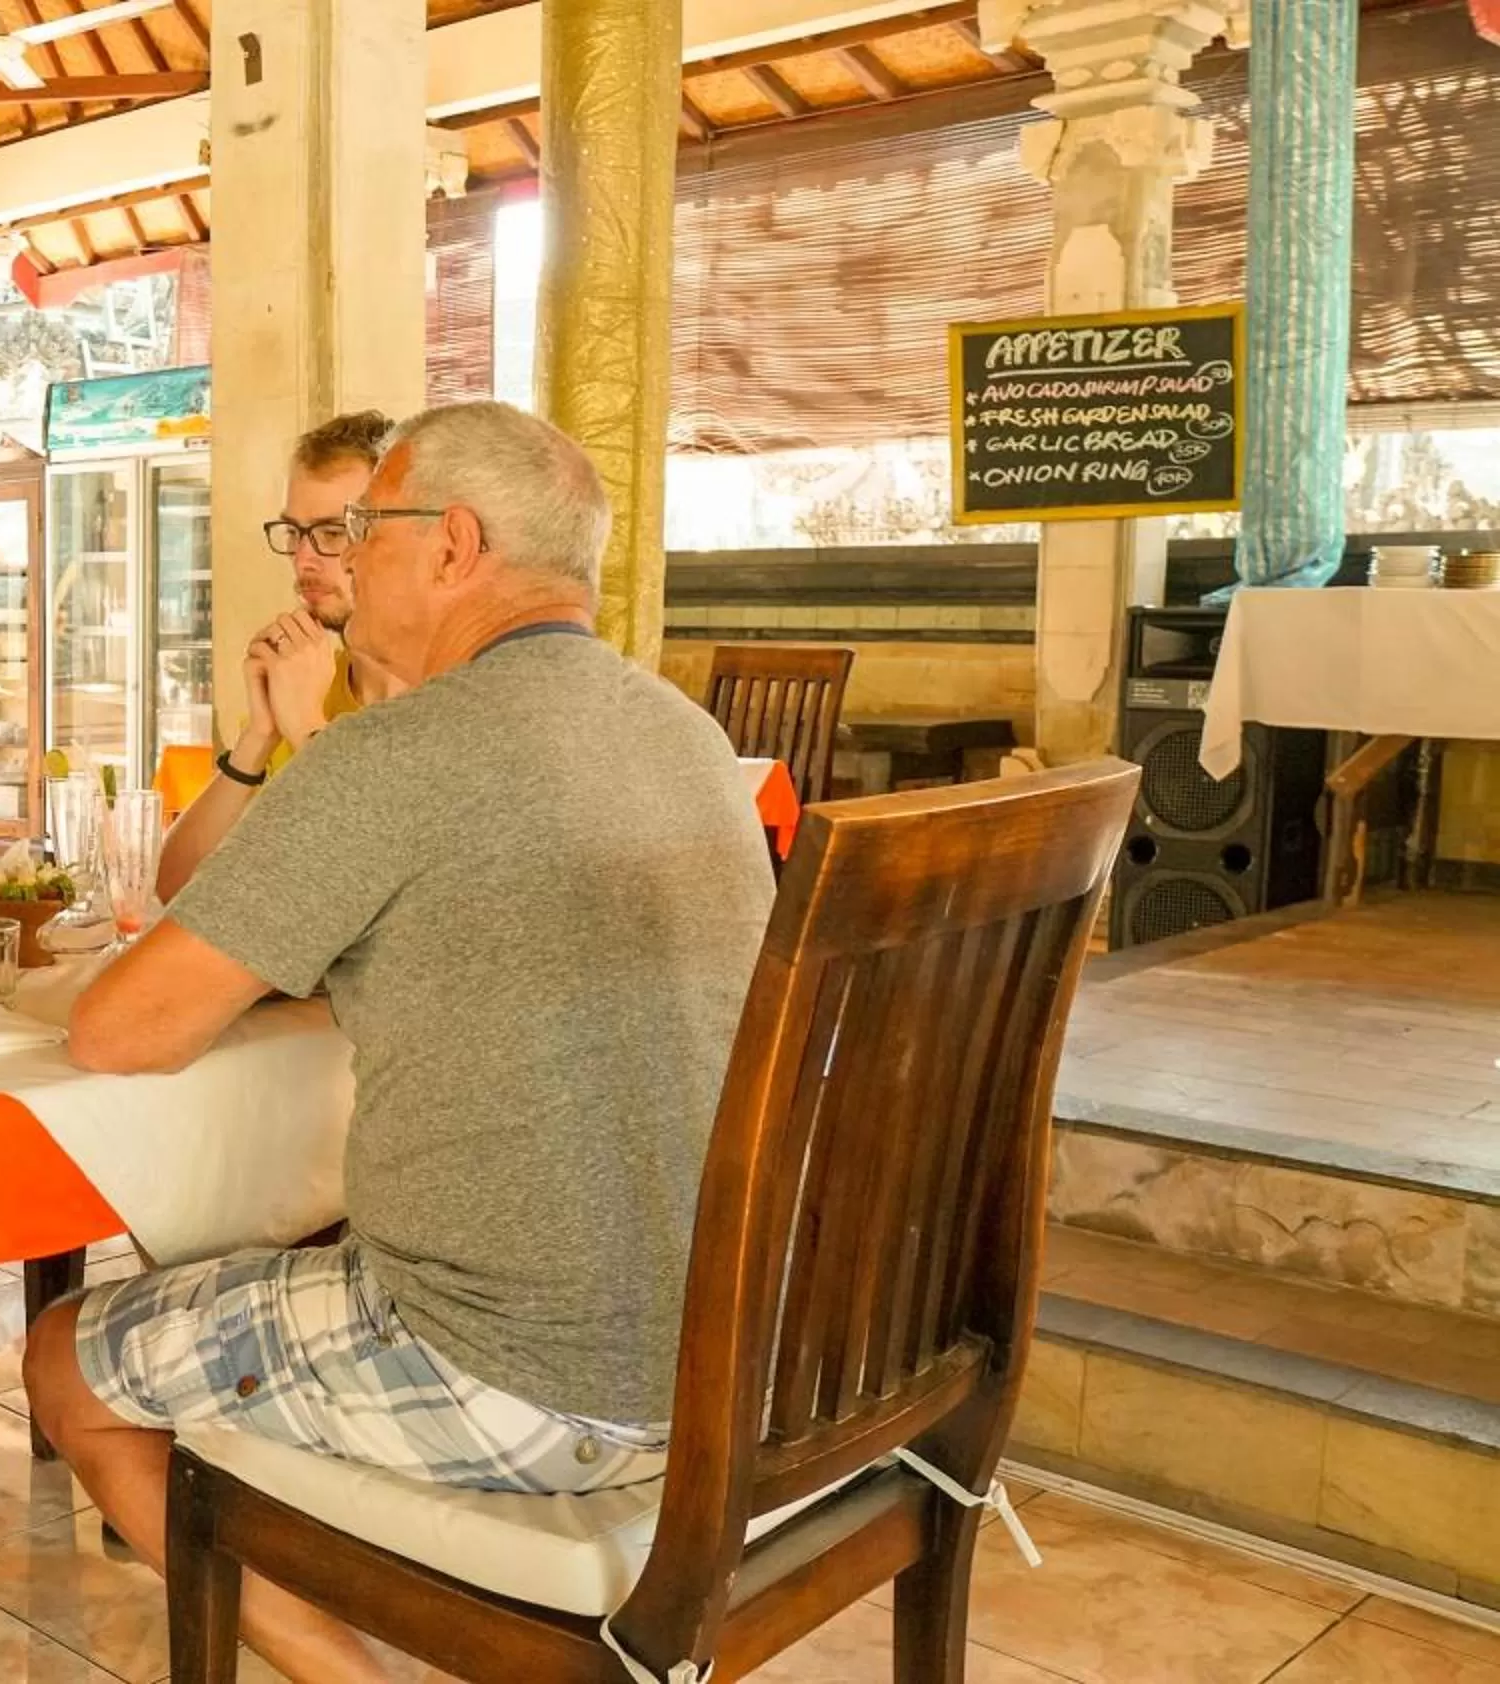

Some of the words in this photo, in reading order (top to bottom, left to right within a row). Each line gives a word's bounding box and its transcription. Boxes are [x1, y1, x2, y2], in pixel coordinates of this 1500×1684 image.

[985, 327, 1187, 369] APPETIZER
[981, 381, 1081, 402] AVOCADO
[1080, 375, 1159, 398] SHRIMP
[1155, 375, 1214, 394] SALAD
[979, 407, 1059, 428] FRESH
[1061, 403, 1149, 427] GARDEN
[1149, 403, 1211, 422] SALAD
[985, 433, 1081, 453] GARLIC
[1083, 428, 1179, 452] BREAD
[983, 460, 1080, 488] ONION
[1081, 458, 1150, 483] RING
